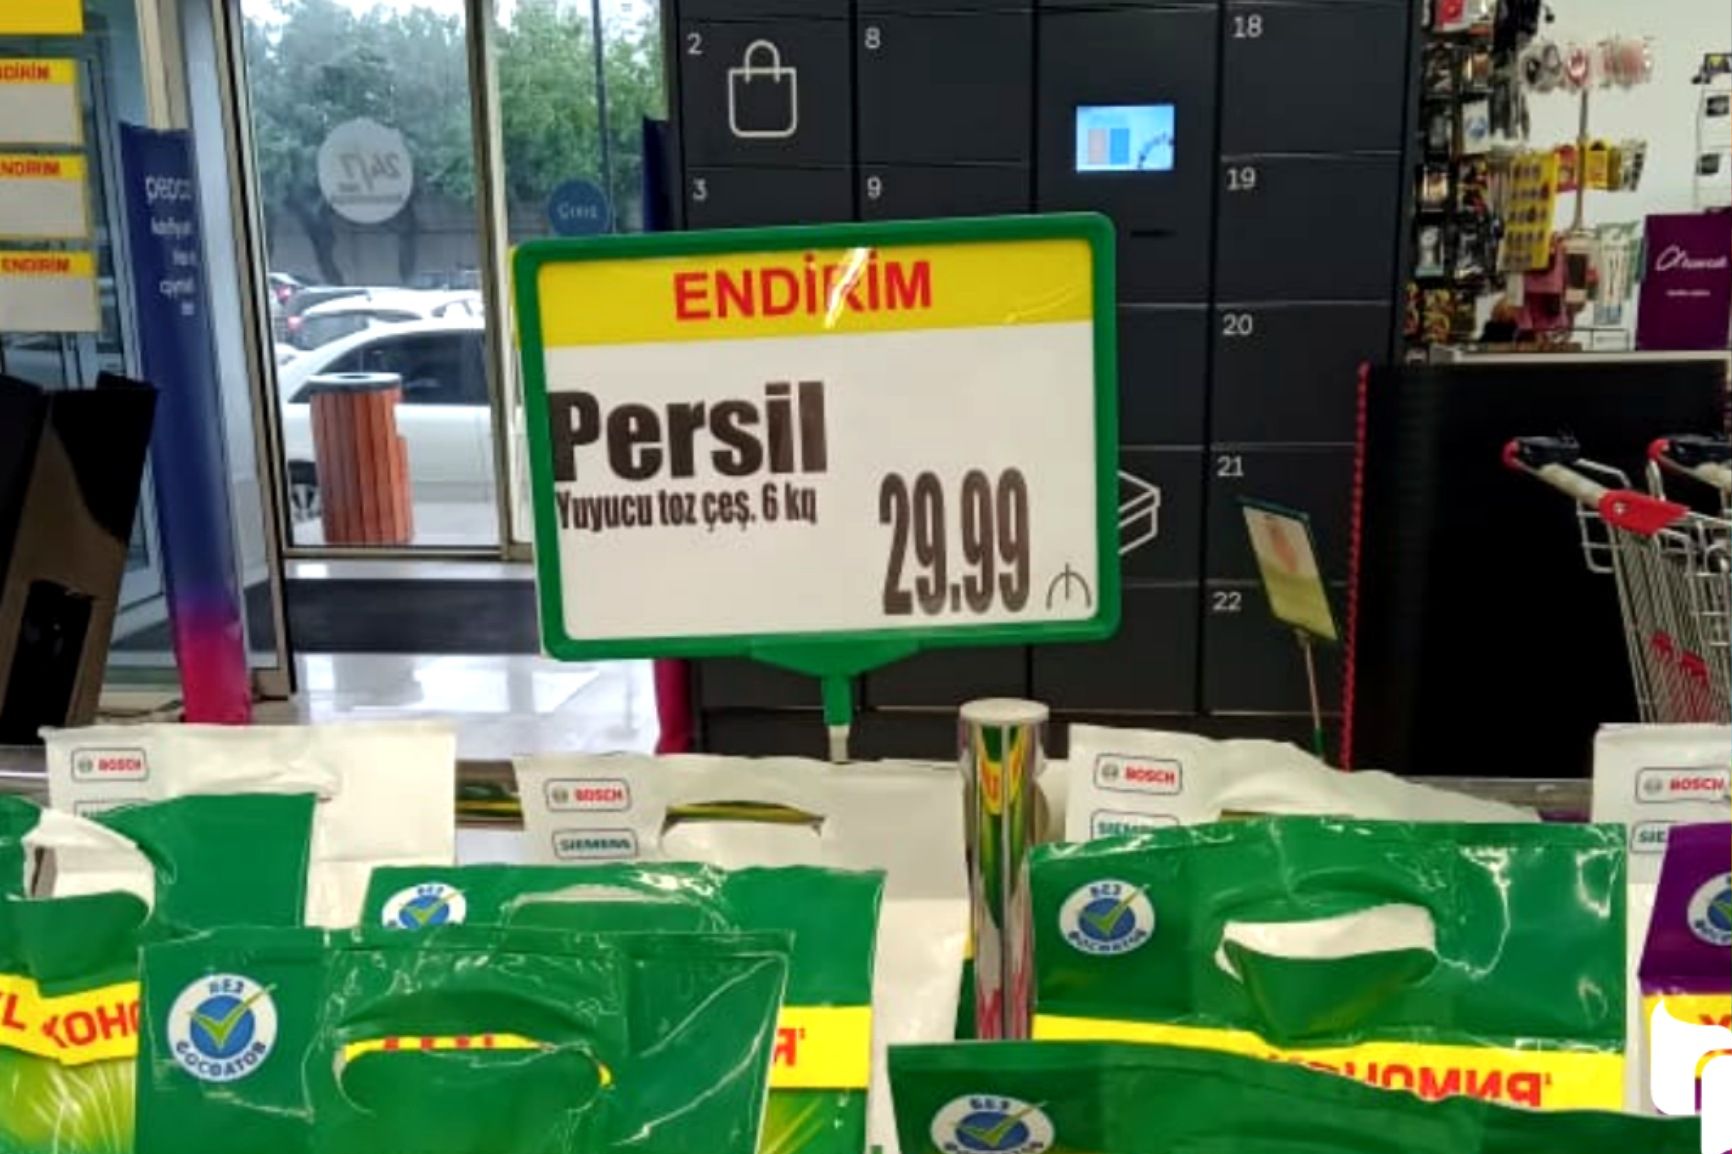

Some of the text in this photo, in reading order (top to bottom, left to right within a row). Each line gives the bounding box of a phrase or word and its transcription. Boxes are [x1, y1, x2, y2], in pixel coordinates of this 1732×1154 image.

[1233, 16, 1262, 39] 18
[687, 33, 703, 55] 2
[864, 28, 881, 49] 8
[867, 177, 882, 199] 9
[1226, 168, 1256, 191] 19
[692, 180, 707, 201] 3
[673, 251, 933, 320] ENDİRİM
[1222, 315, 1253, 336] 20
[547, 381, 828, 483] Persil
[1217, 456, 1244, 477] 21
[556, 490, 653, 531] Yuyucu
[659, 491, 697, 526] toz
[762, 483, 779, 521] 6
[879, 467, 1032, 617] 29.99
[1213, 592, 1242, 612] 22
[98, 757, 142, 772] BOSCH
[1125, 766, 1175, 784] BOSCH
[575, 787, 623, 802] BOSCH
[559, 838, 631, 851] SIEMENS
